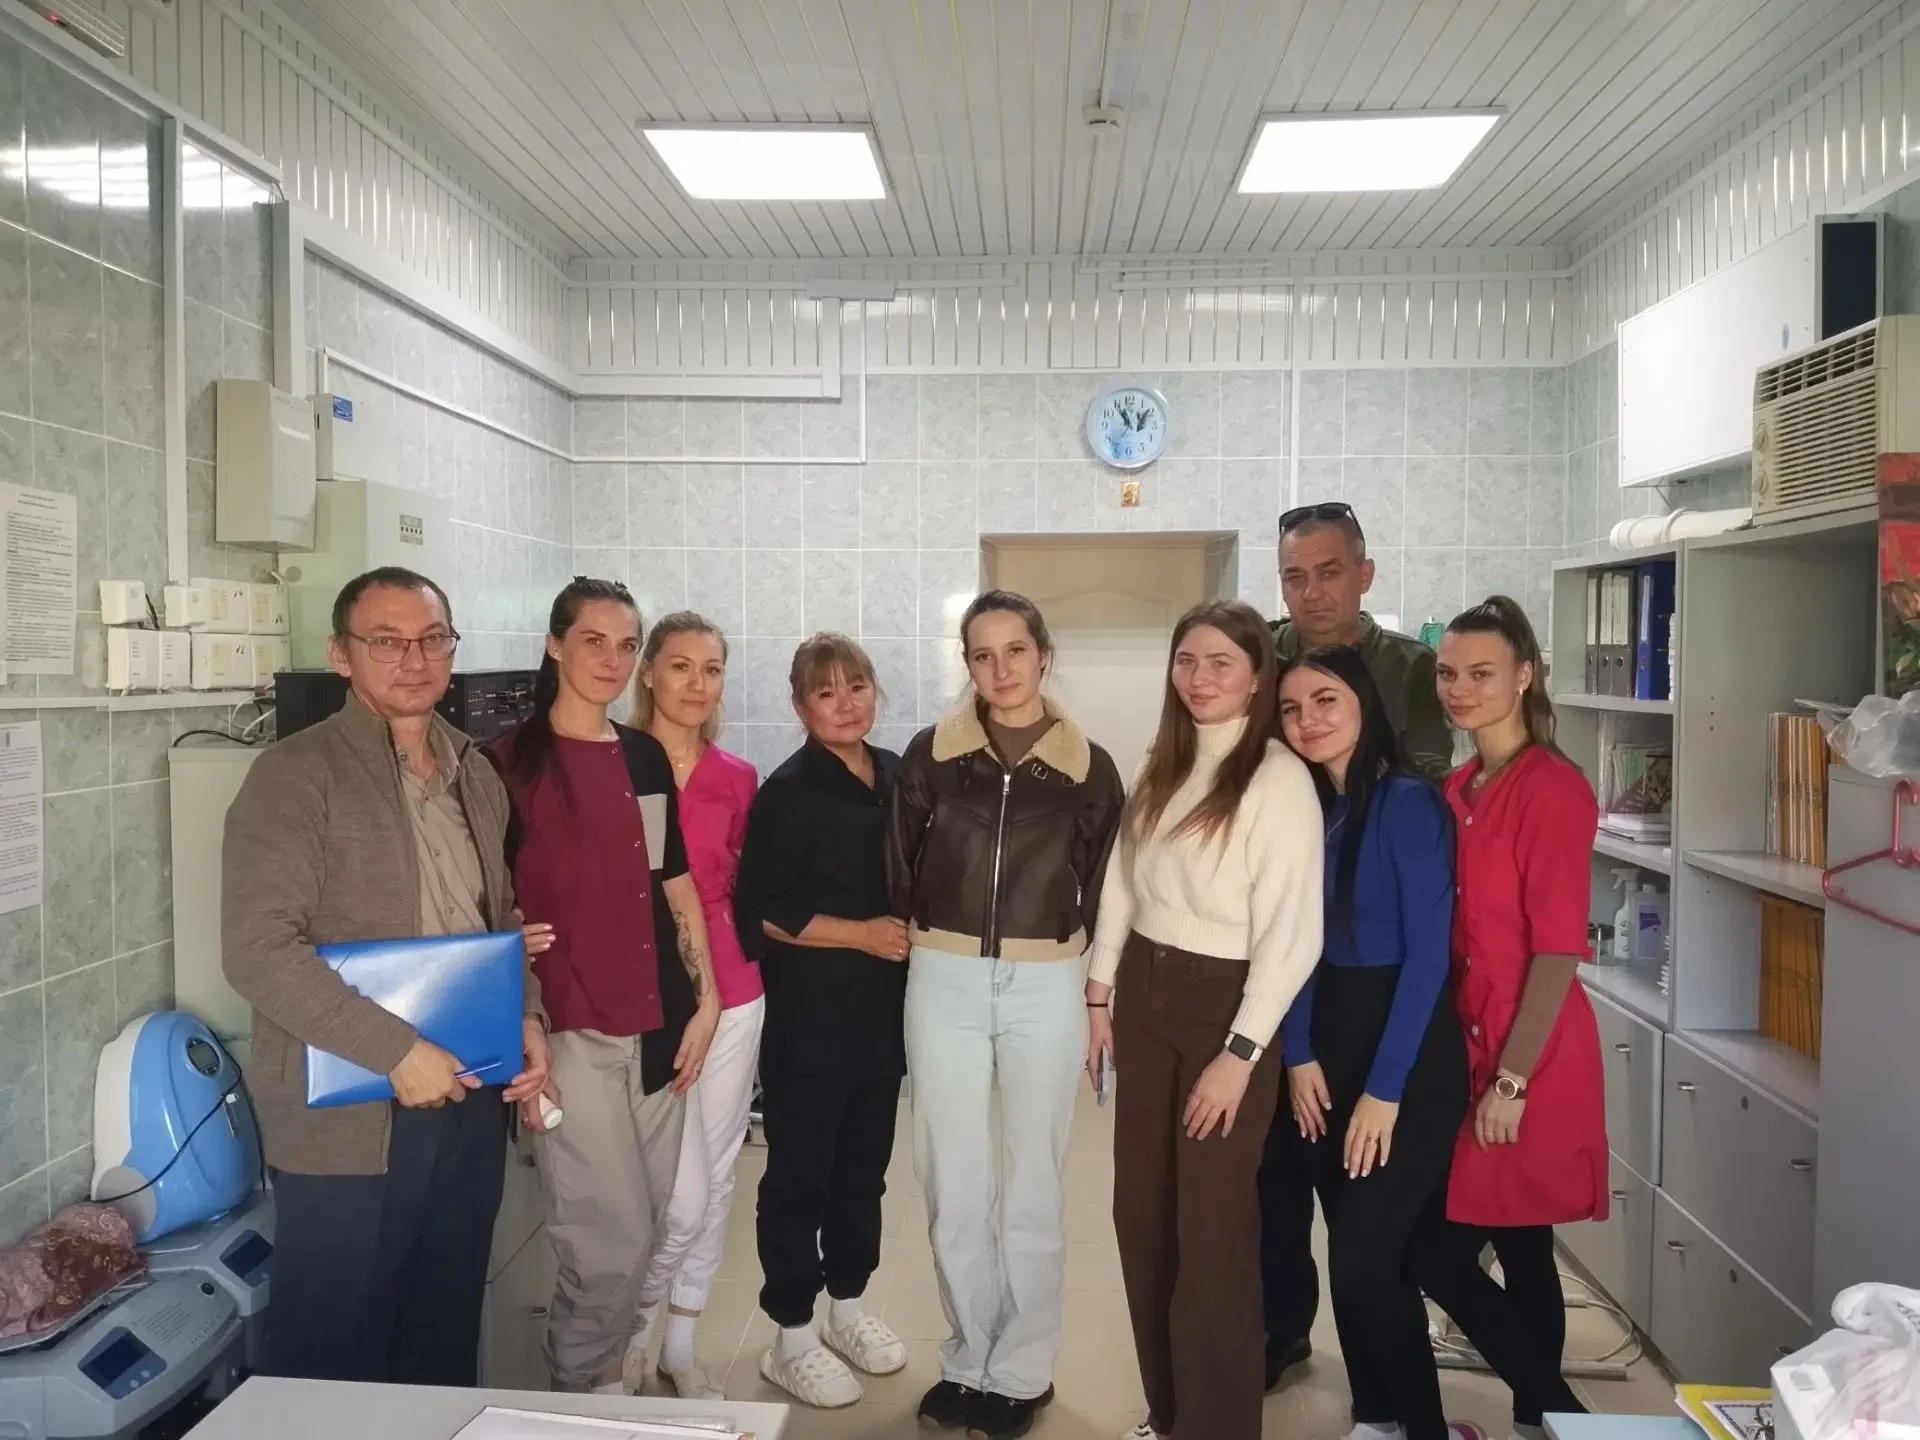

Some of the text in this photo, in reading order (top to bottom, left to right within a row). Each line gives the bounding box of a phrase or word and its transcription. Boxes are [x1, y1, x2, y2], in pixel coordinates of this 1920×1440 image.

[1125, 396, 1135, 406] 12
[1140, 399, 1144, 408] 1
[1103, 408, 1114, 418] 10
